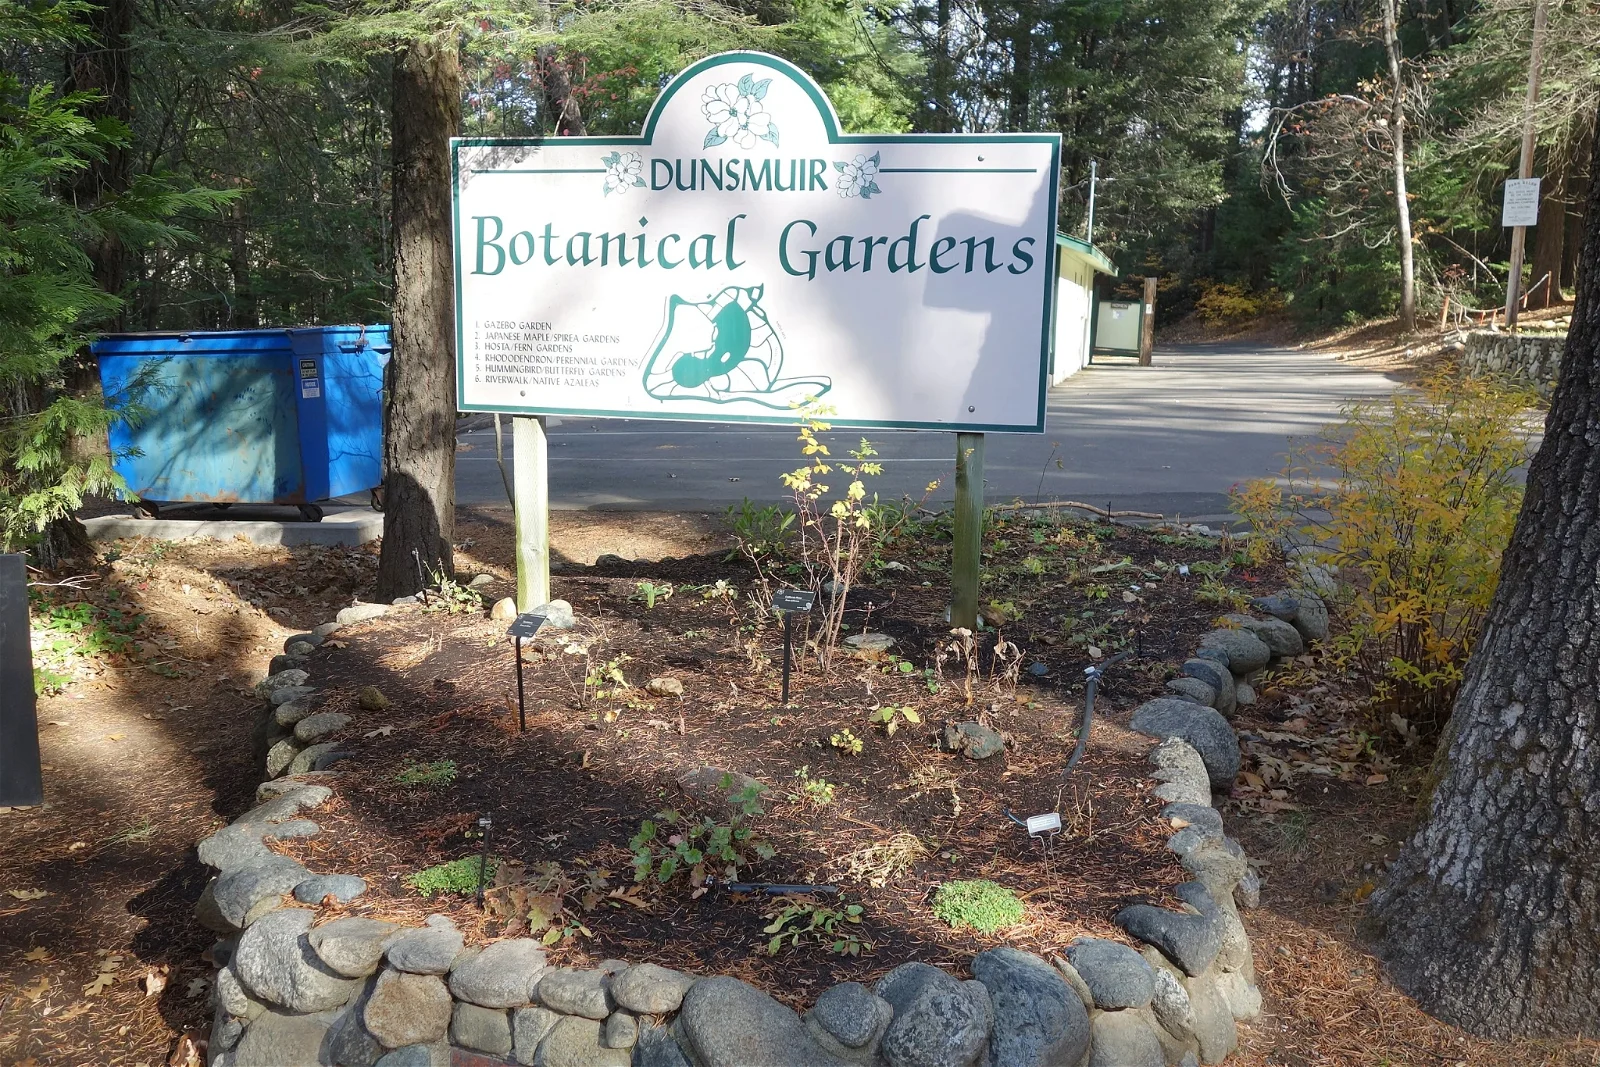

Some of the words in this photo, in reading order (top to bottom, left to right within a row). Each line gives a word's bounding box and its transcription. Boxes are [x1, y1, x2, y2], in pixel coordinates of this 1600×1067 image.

[651, 158, 828, 191] DUNSMUIR
[470, 213, 747, 276] Botanical
[778, 214, 1036, 282] Gardens
[484, 321, 516, 329] GAZEBO
[519, 321, 552, 330] GARDEN
[474, 332, 481, 340] 2.
[485, 332, 521, 341] JAPANESE
[523, 333, 579, 343] MAPLE/SPIREA
[582, 334, 620, 344] GARDENS
[474, 342, 481, 350] 3.
[484, 342, 533, 352] HOSTA/FERN
[536, 344, 573, 353] GARDENS
[474, 353, 481, 361] 4.
[485, 354, 598, 366] RHODODENDRON/PERENNIAL
[601, 357, 639, 367] GARDENS
[475, 364, 482, 372] 5.
[485, 364, 585, 376] HUMMINGBIRD/BUTTERFLY
[588, 367, 626, 377] GARDENS
[474, 375, 482, 383] 6.
[485, 375, 560, 386] RIVERWALK/NATIVE
[564, 378, 600, 388] AZALEAS
